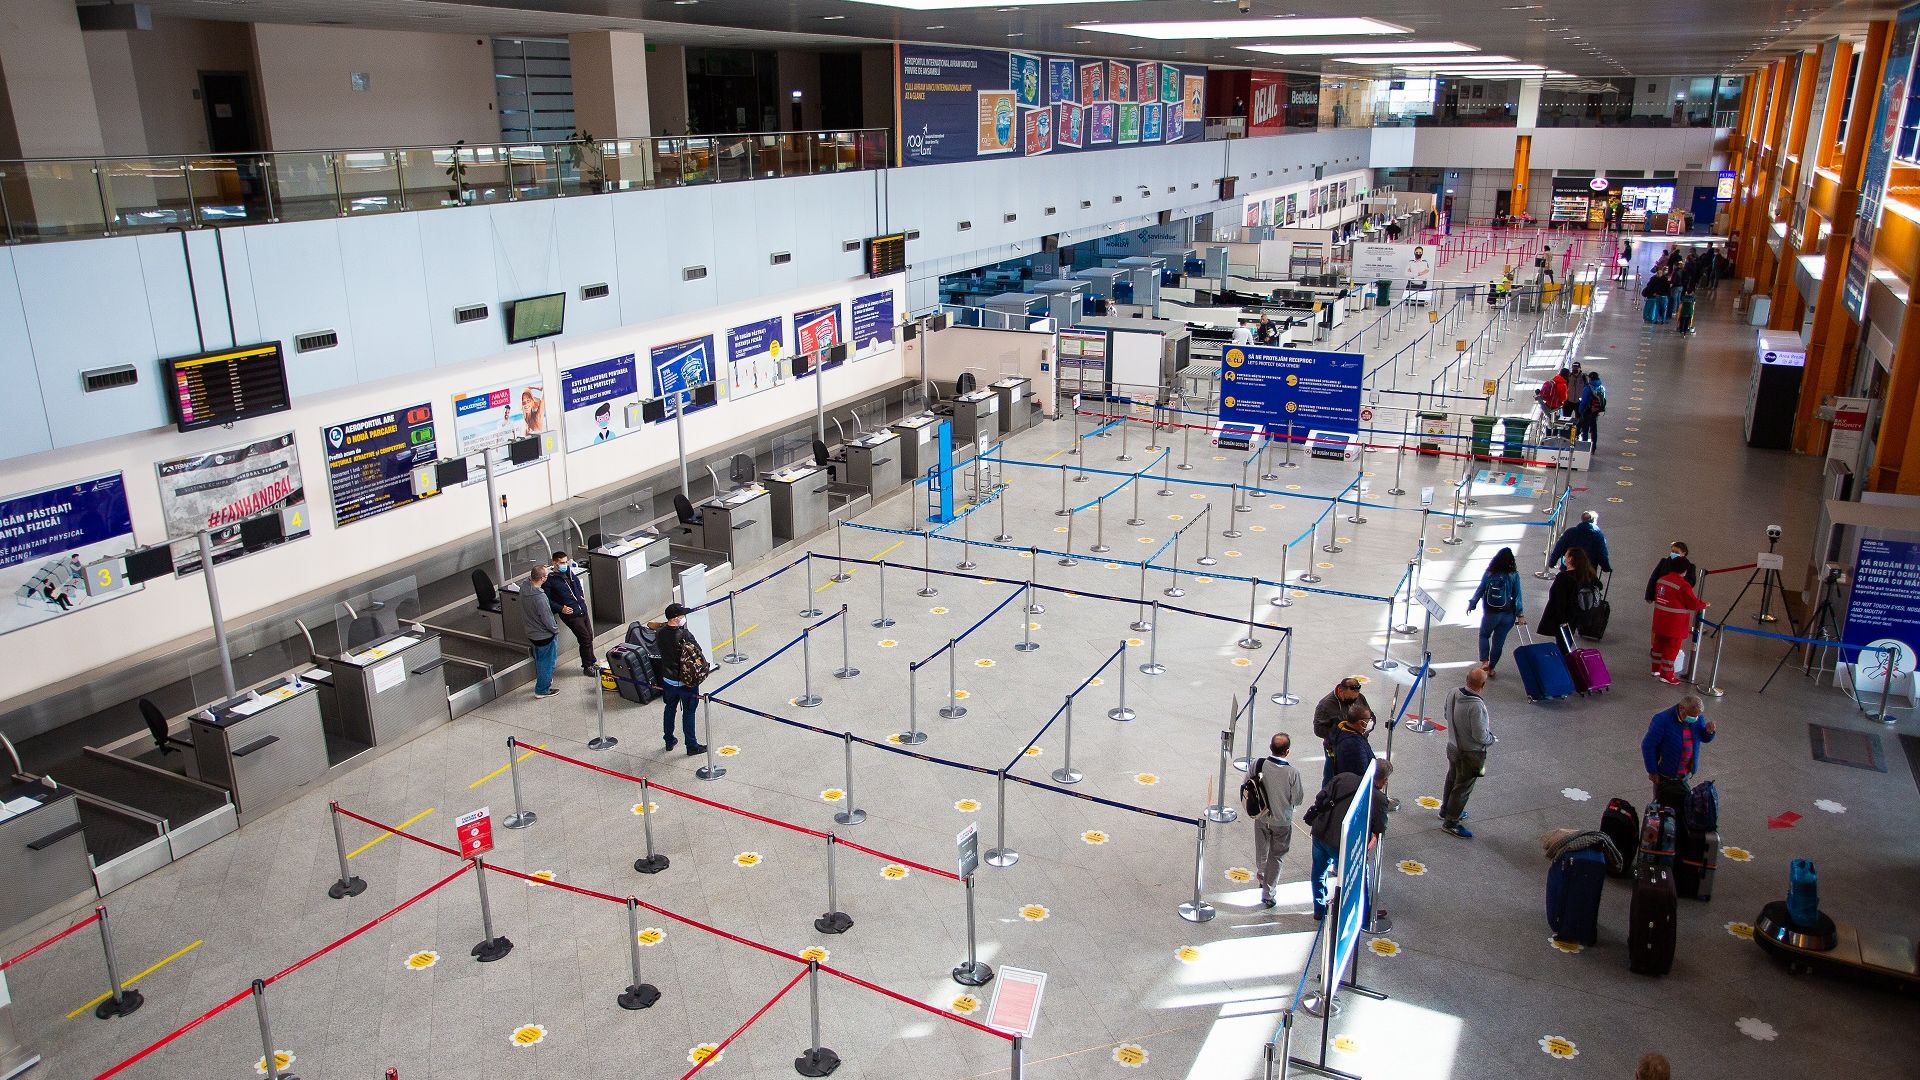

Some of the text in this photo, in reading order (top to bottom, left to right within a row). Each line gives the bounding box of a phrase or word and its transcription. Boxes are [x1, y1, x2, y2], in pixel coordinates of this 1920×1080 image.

[345, 414, 395, 434] AEROPORTUL ARE
[421, 472, 430, 488] 5
[208, 475, 294, 528] #FANHANDBAL
[26, 502, 72, 520] PĂSTRAȚI
[291, 511, 302, 527] 4
[26, 516, 61, 532] FIZICĂ!
[11, 538, 47, 553] MAINTAIN
[49, 528, 85, 543] PHYSICAL
[1859, 568, 1895, 577] ATINGEȚI
[1873, 560, 1902, 568] RUGĂM
[98, 568, 112, 587] 3
